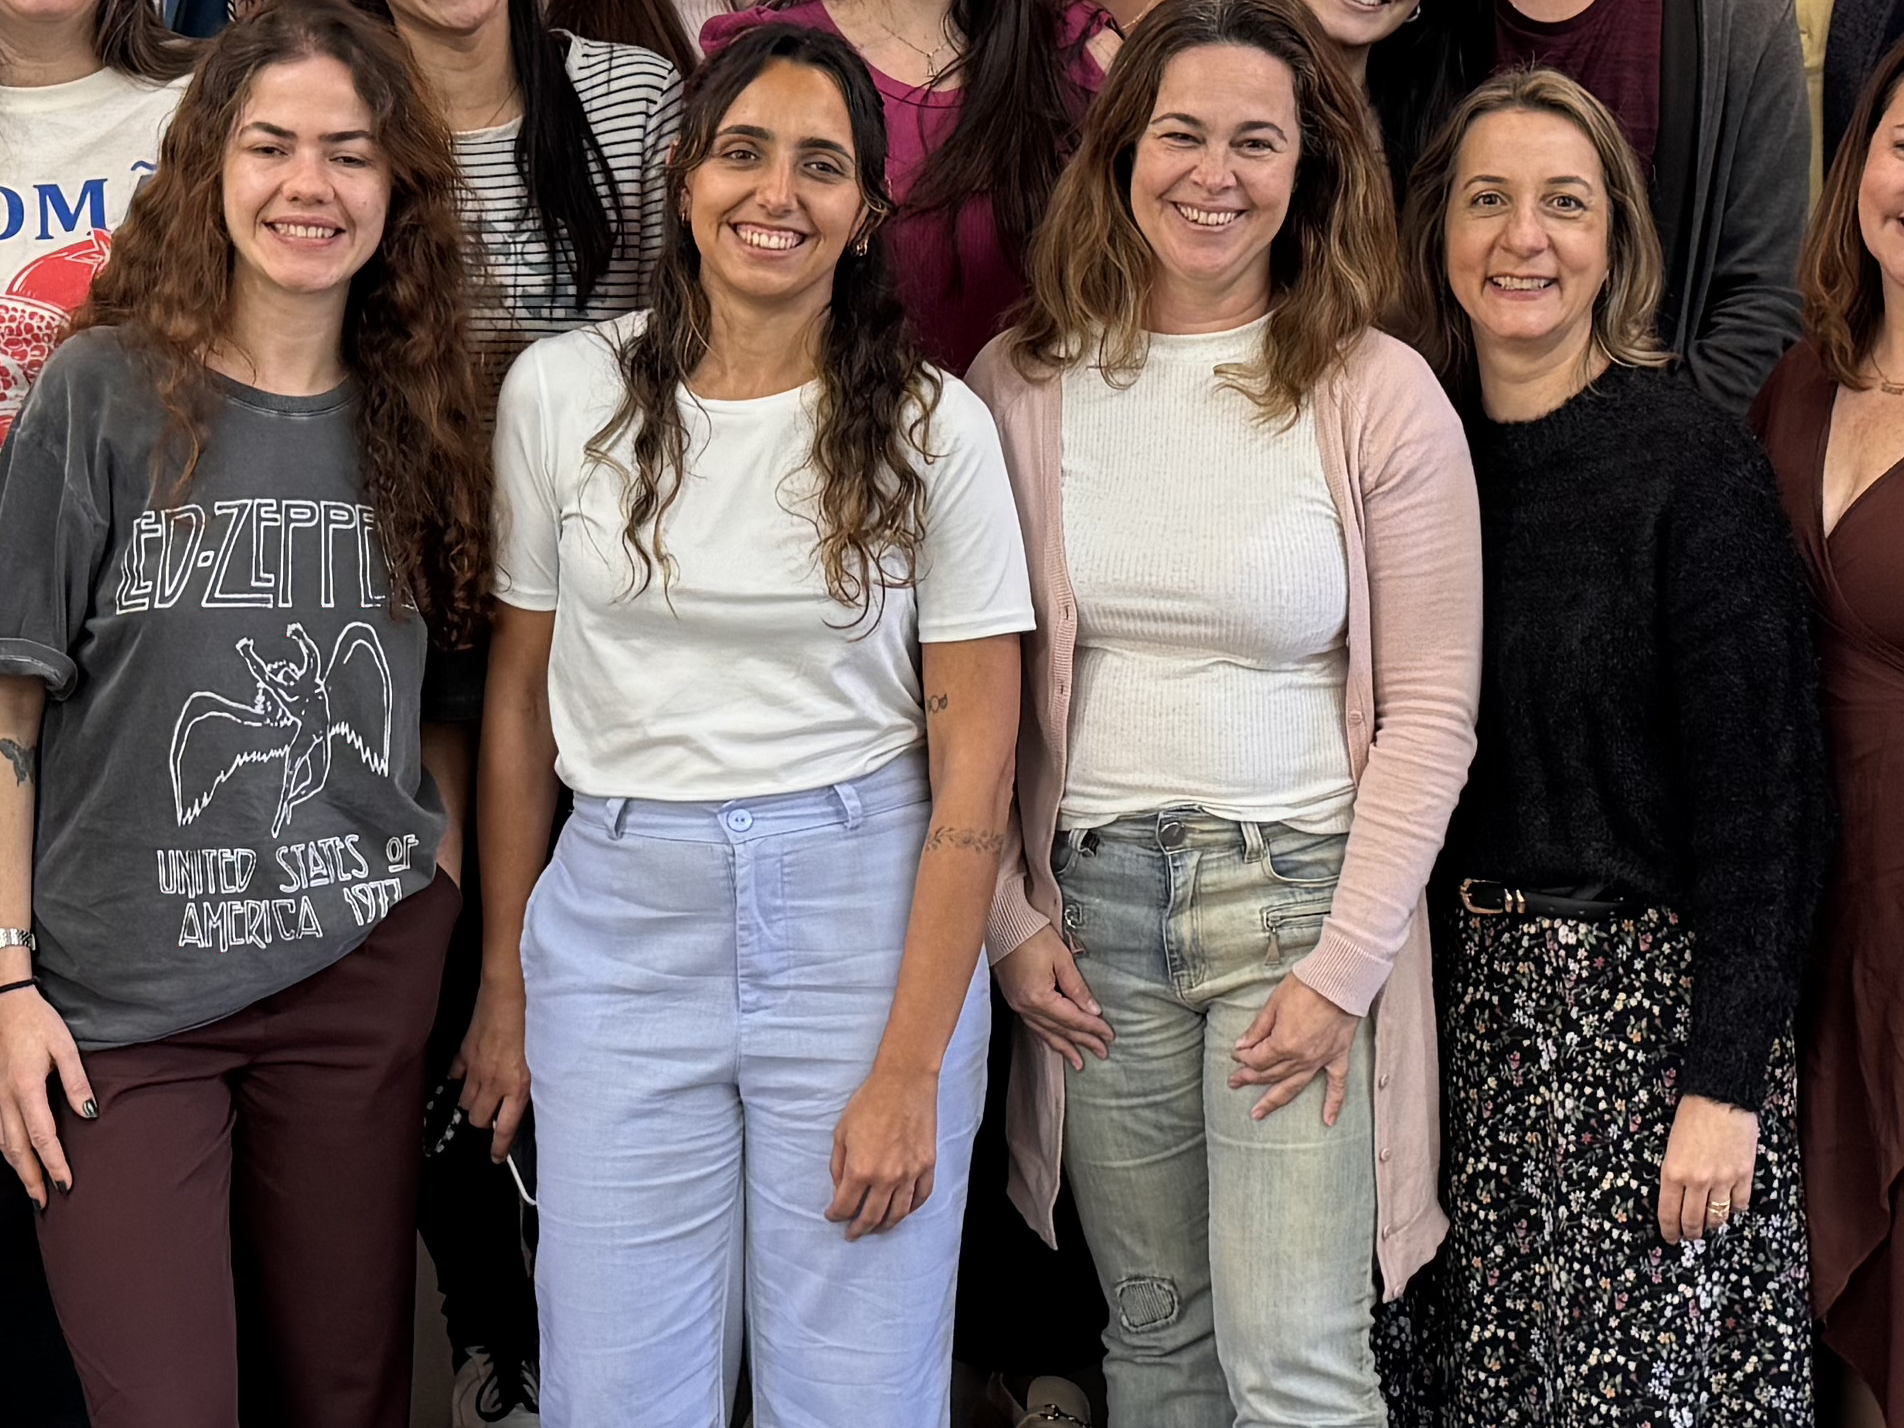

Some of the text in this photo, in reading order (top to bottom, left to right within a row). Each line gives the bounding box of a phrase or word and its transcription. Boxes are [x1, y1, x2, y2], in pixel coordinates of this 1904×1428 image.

[157, 833, 420, 899] UNITED STATES OF
[178, 877, 403, 953] AMERICA 1977
